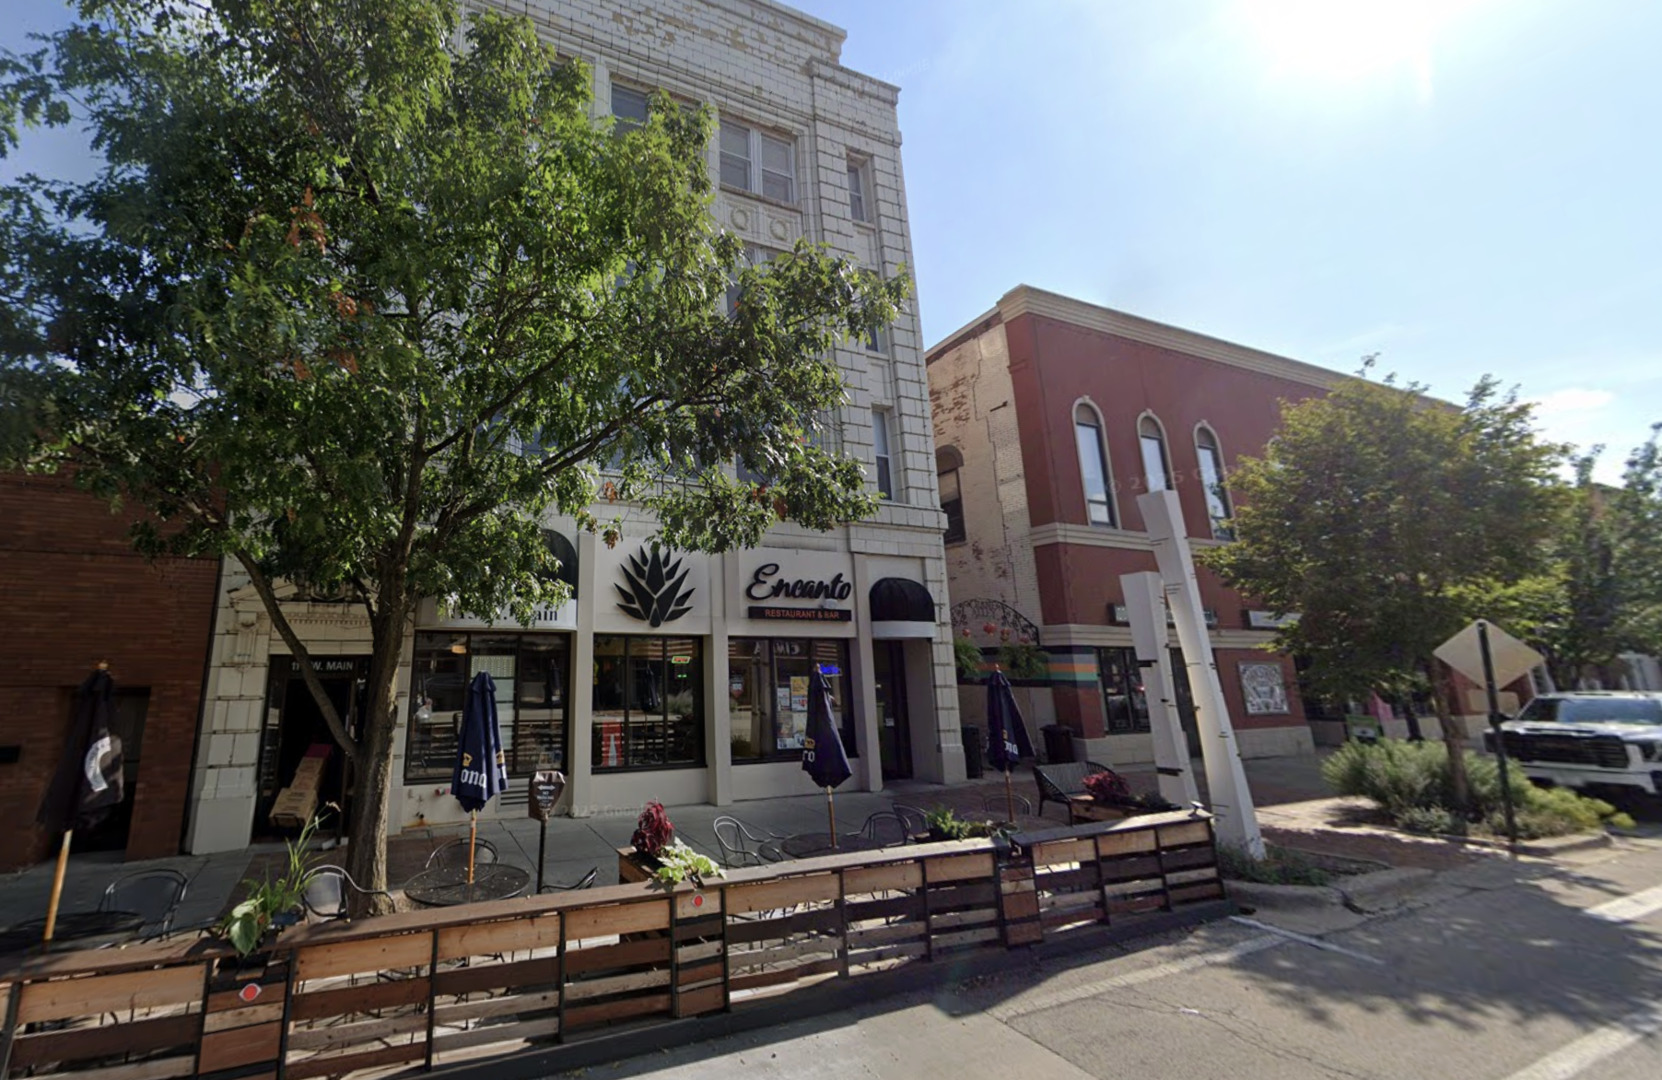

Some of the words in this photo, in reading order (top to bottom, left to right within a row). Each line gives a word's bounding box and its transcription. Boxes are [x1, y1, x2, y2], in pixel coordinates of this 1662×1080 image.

[746, 562, 852, 601] Encanto
[764, 608, 816, 618] RESTAURANT
[817, 610, 823, 619] &
[824, 610, 840, 619] BAR
[326, 661, 353, 671] MAIN
